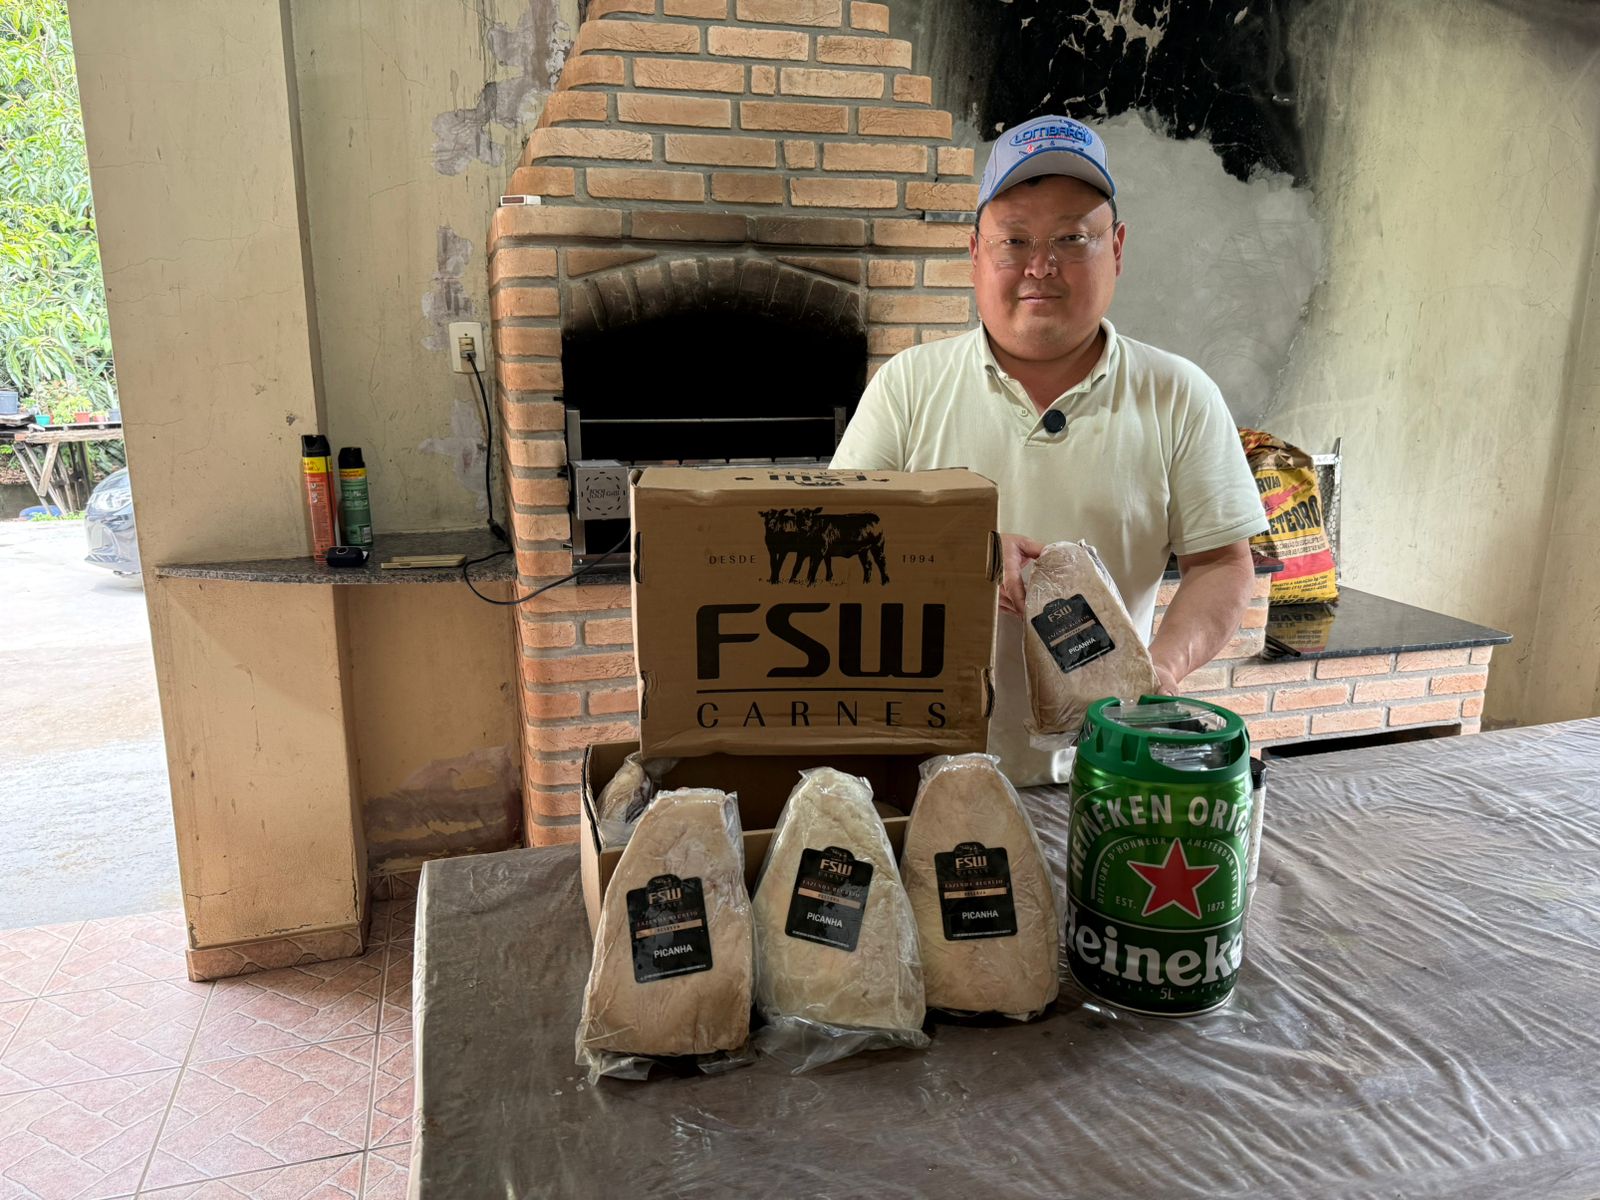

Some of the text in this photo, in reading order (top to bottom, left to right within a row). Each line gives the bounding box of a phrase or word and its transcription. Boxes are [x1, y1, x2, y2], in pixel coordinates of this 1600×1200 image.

[1267, 495, 1321, 536] ETEORO
[709, 554, 757, 565] DESDE
[901, 554, 935, 564] 1994
[1047, 604, 1073, 623] FSW
[696, 603, 945, 680] FSW
[1068, 637, 1096, 655] PICANHA
[696, 701, 947, 729] CARNES
[1070, 795, 1173, 881] HEINEKEN
[820, 859, 853, 876] FSW
[955, 855, 988, 869] FSW
[648, 887, 682, 905] FSW
[1115, 896, 1137, 909] EST.
[1207, 900, 1225, 912] 1873
[806, 912, 843, 928] PICANHA
[962, 910, 999, 920] PICANHA
[653, 944, 693, 959] PICANHA
[1160, 987, 1175, 1000] 5L
